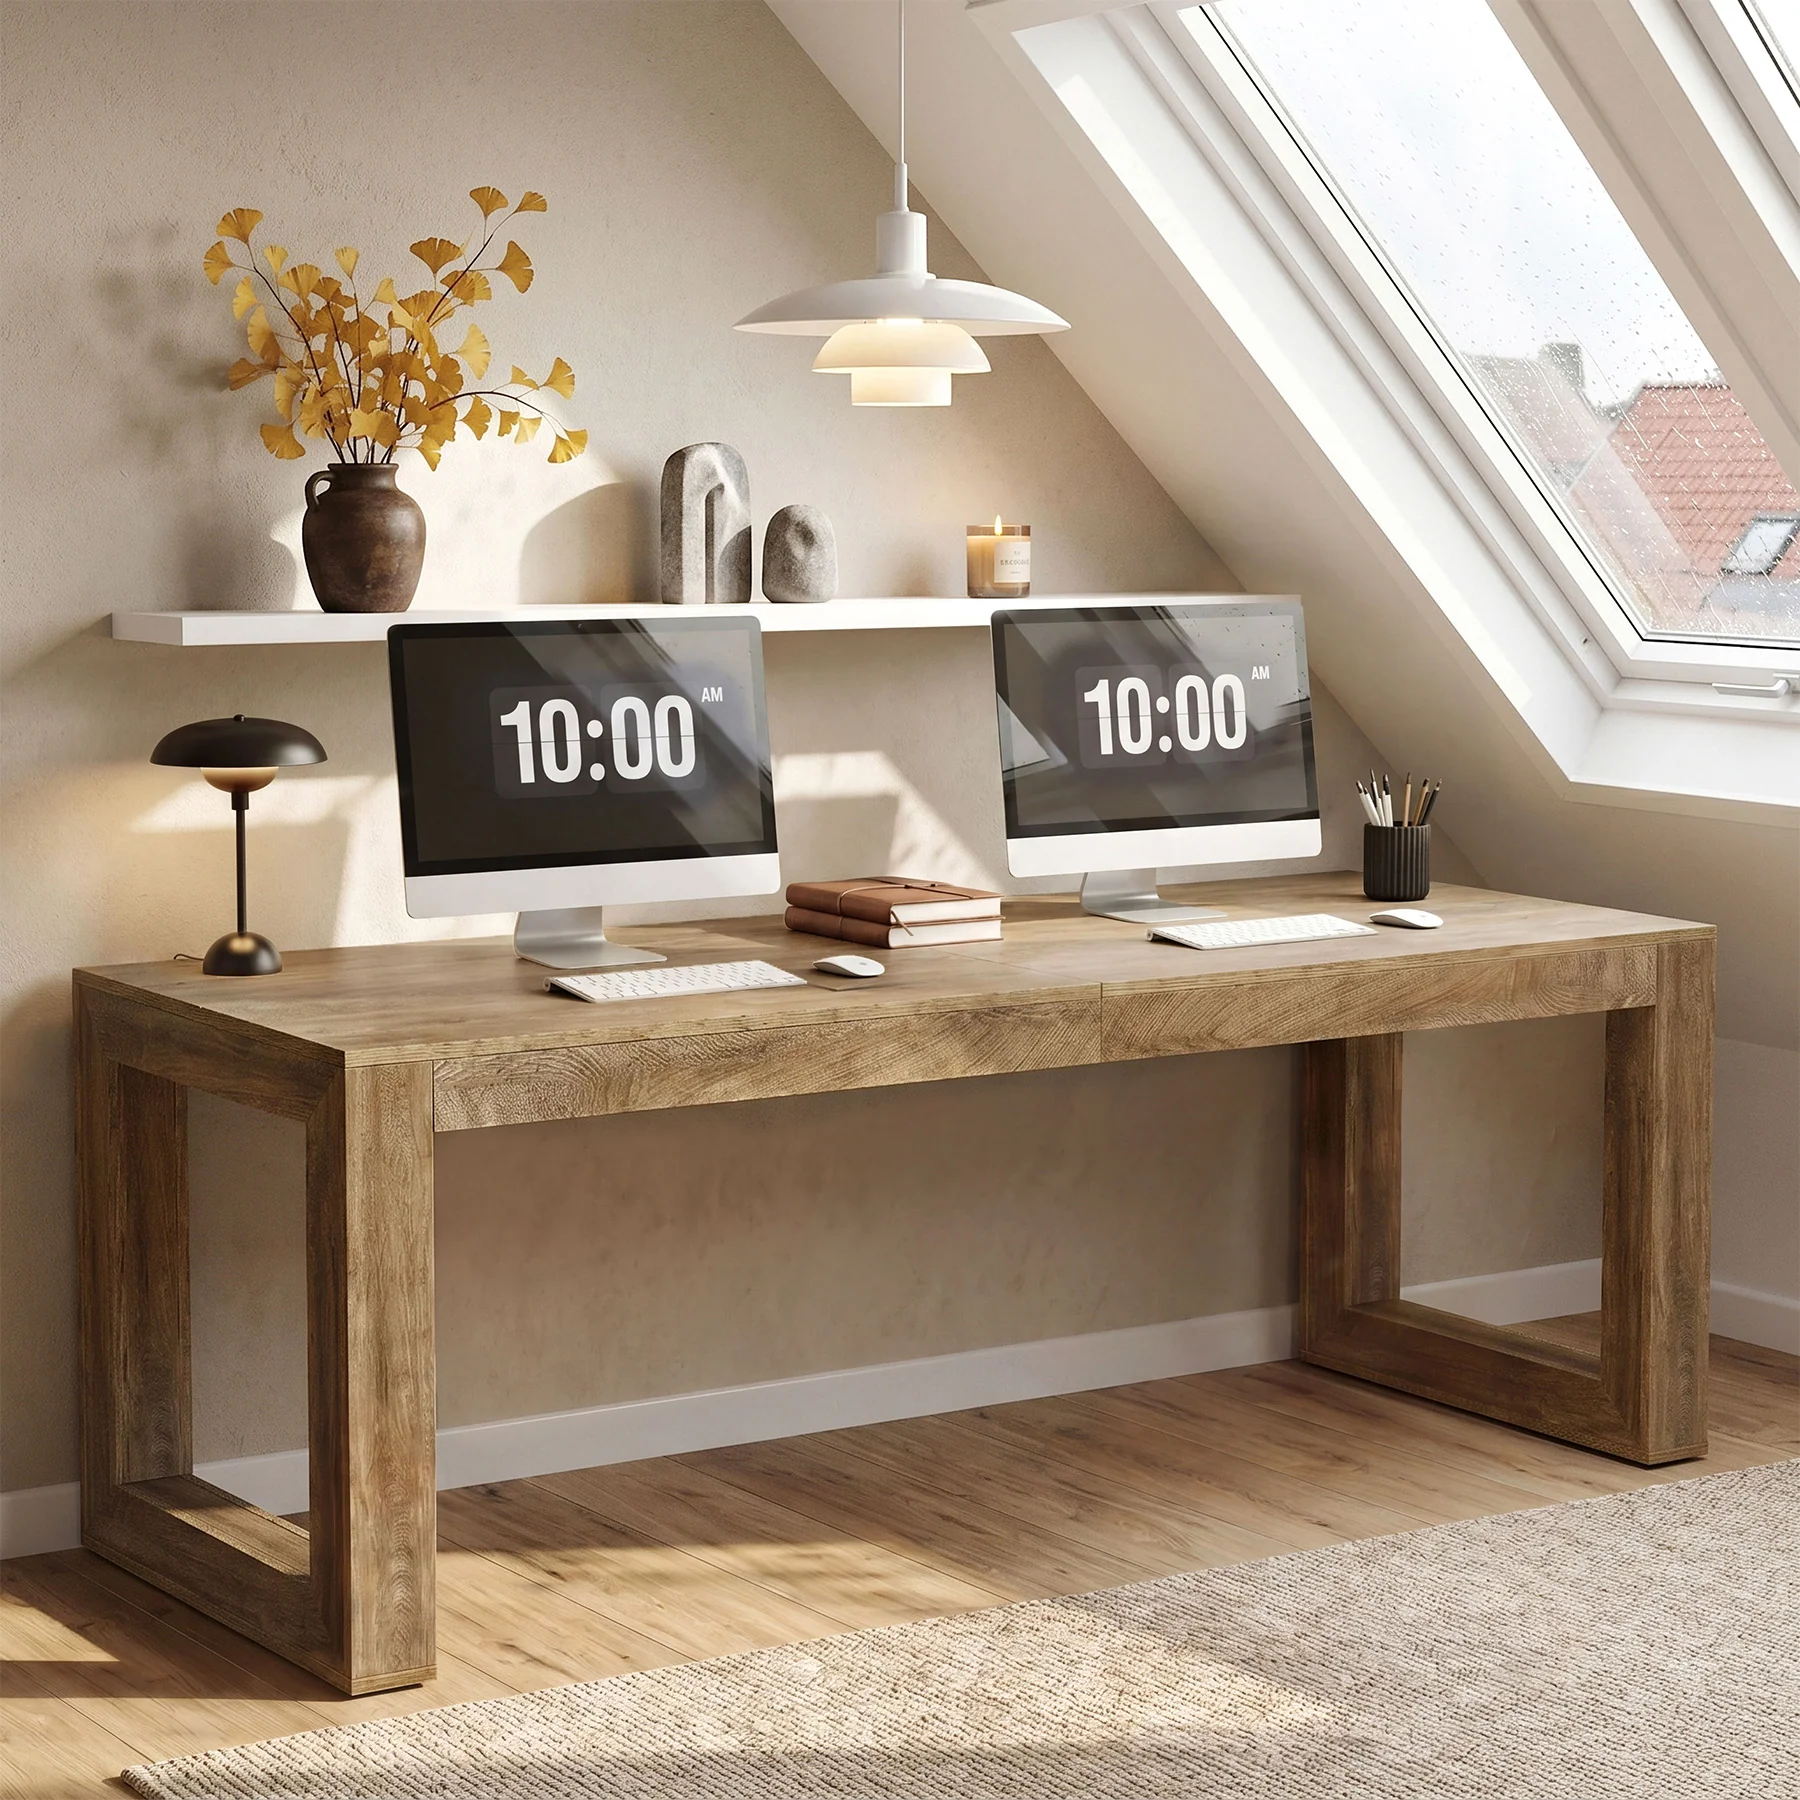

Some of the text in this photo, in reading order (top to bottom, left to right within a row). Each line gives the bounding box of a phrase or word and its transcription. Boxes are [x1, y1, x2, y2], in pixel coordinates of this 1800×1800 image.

[500, 687, 723, 783] 10:00 AM
[1084, 666, 1270, 755] 10:00 AM
